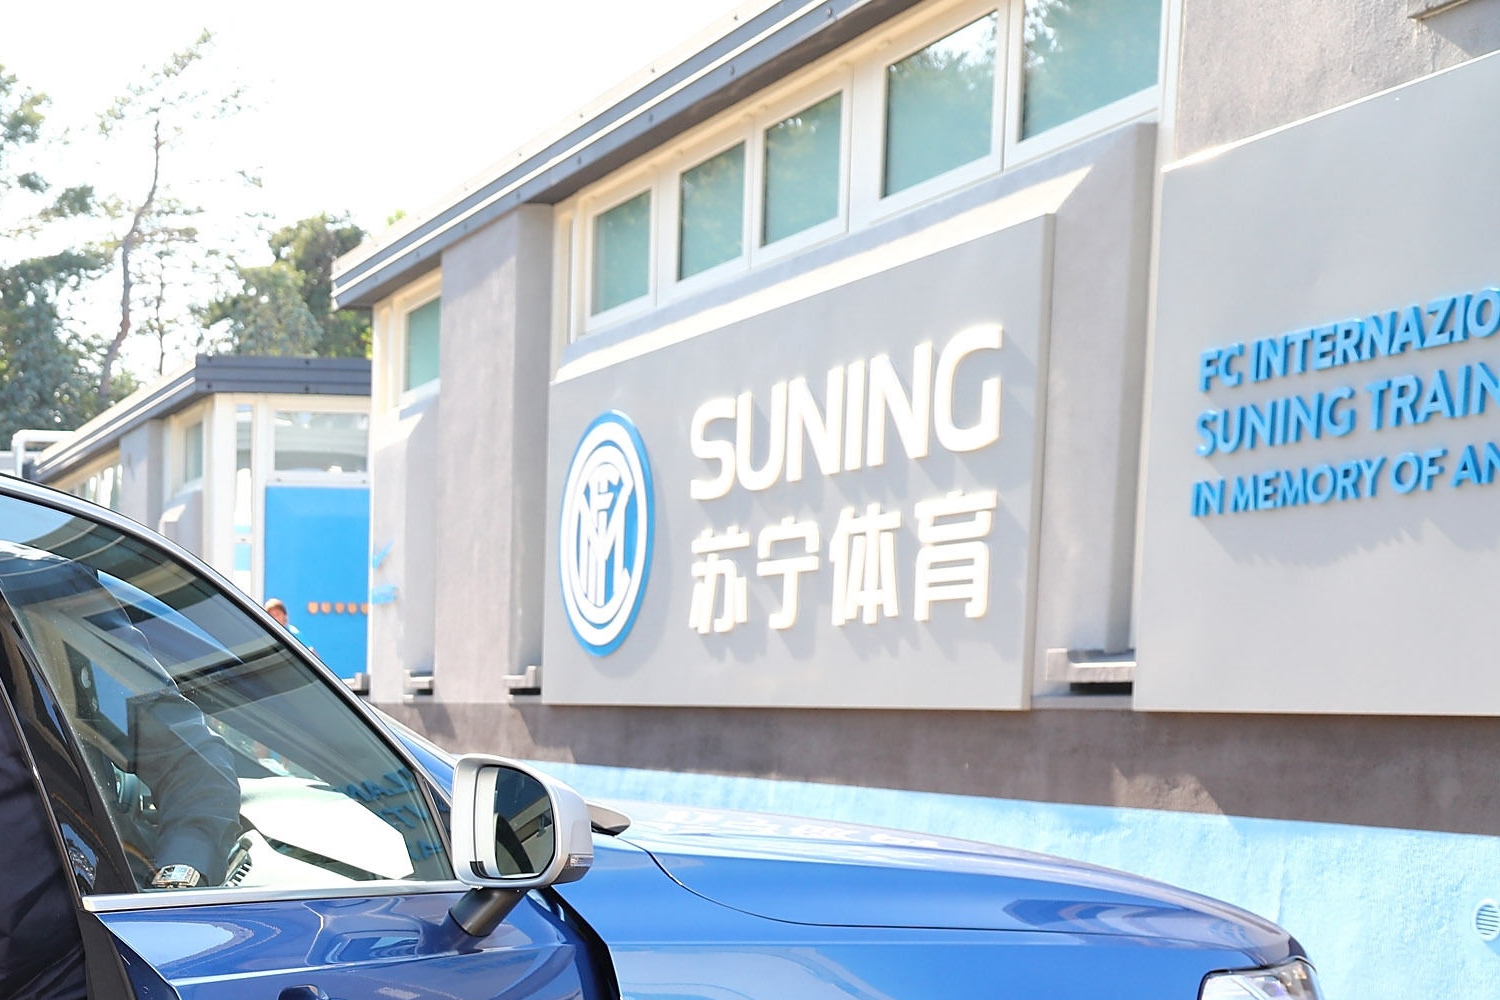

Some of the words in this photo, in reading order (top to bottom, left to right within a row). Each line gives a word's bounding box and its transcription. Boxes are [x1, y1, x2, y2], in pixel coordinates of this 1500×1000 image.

[1199, 343, 1245, 392] FC
[1250, 286, 1500, 383] INTERNAZIO
[690, 324, 1003, 500] SUNING
[1195, 386, 1356, 457] SUNING
[1365, 361, 1500, 431] TRAIN
[1190, 478, 1225, 517] IN
[1229, 456, 1387, 513] MEMORY
[1390, 448, 1448, 495] OF
[688, 489, 998, 635] 苏宁体育
